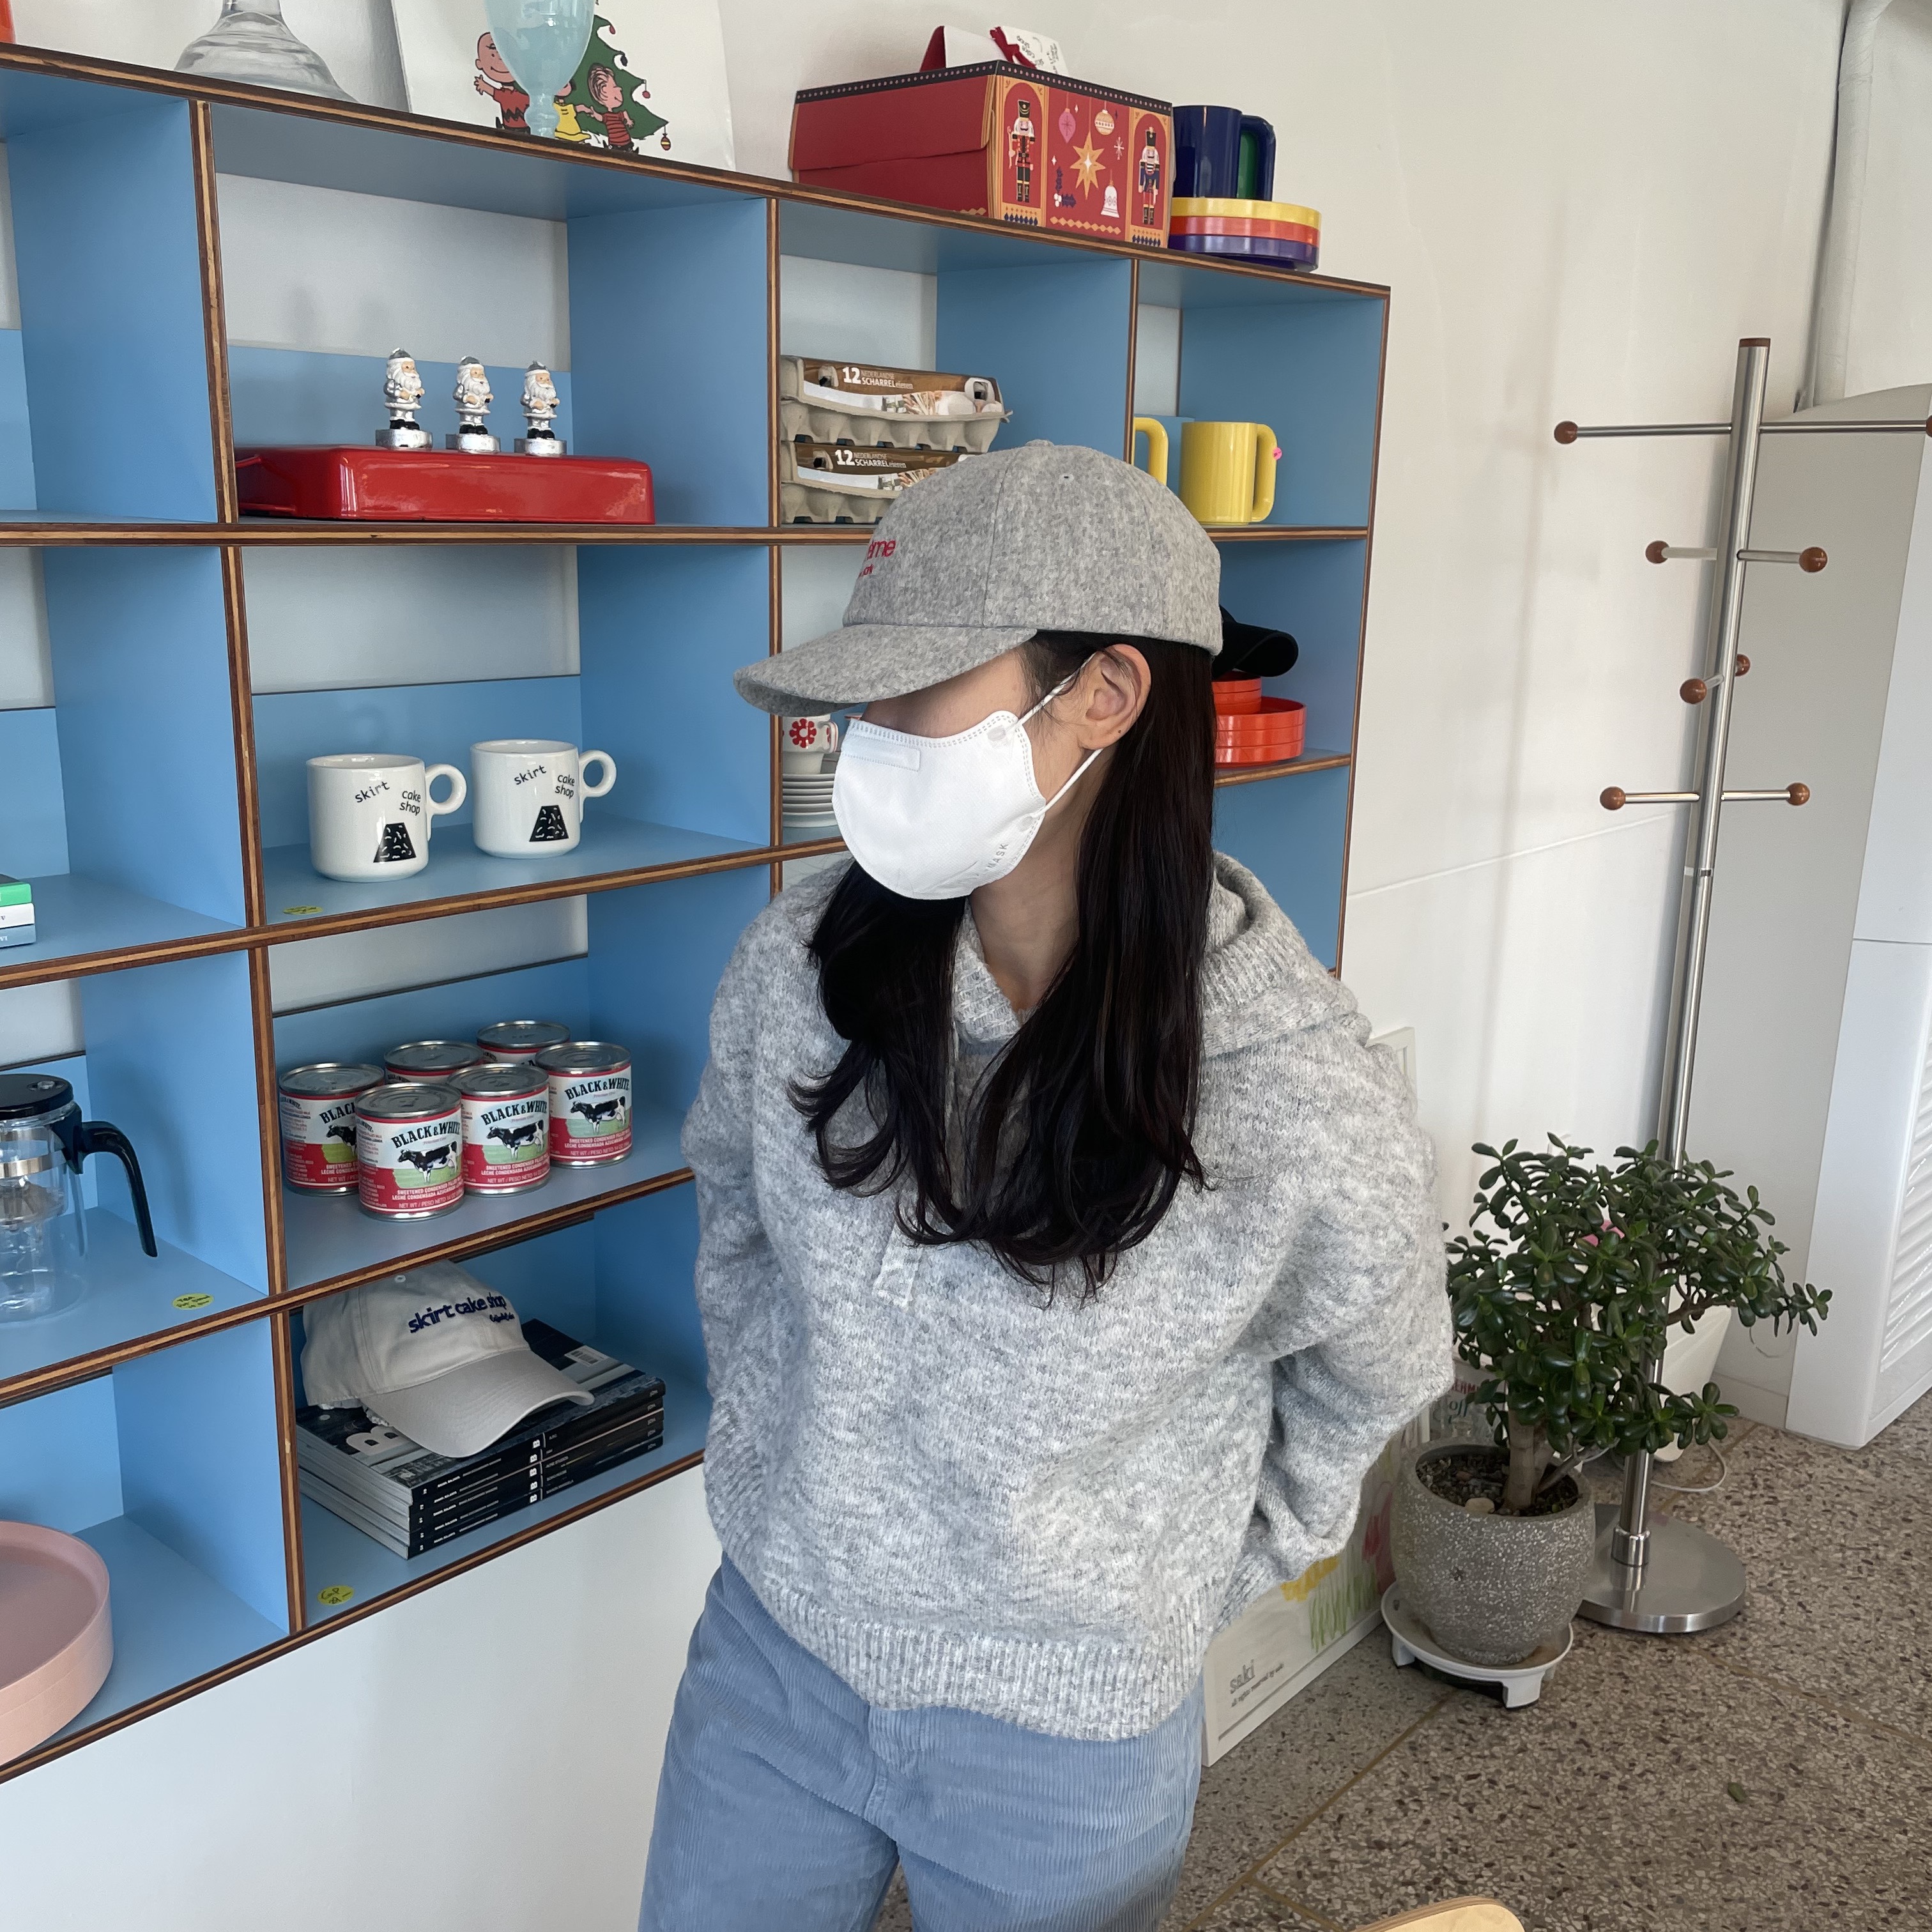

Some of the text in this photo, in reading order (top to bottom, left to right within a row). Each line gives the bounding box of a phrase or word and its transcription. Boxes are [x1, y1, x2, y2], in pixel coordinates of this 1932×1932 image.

[843, 367, 861, 384] 12
[835, 449, 855, 466] 12
[514, 765, 547, 785] skirt
[557, 774, 575, 786] cake
[355, 781, 390, 803] skirt
[402, 790, 421, 802] cake
[555, 785, 574, 799] shop
[399, 801, 420, 816] shop
[986, 843, 1009, 869] MASK
[564, 1080, 604, 1100] BLACK
[608, 1078, 630, 1091] WHITE
[480, 1103, 520, 1125] BLACK
[526, 1100, 548, 1114] WHITE
[391, 1125, 432, 1148] BLACK
[408, 1292, 507, 1333] skirt cake shop
